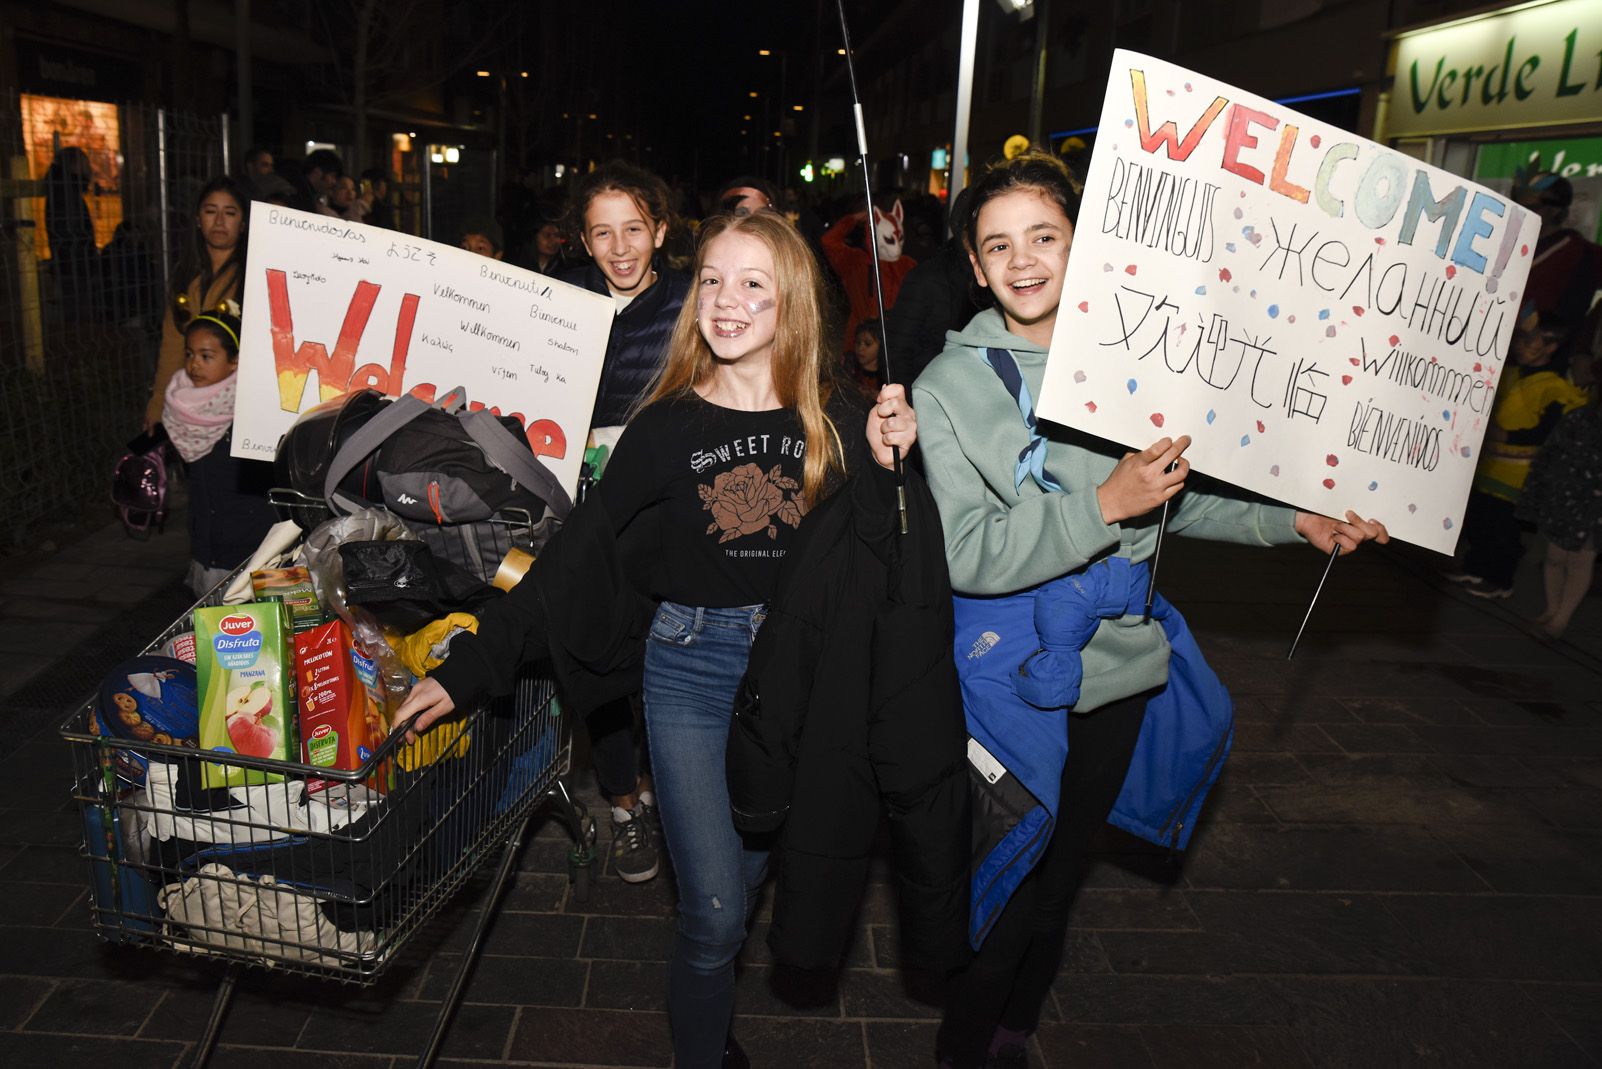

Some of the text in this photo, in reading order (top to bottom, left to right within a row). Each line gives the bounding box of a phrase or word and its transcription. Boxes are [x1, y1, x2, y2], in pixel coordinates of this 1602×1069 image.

[1410, 33, 1541, 114] Verde
[1129, 69, 1527, 293] WELCOME!
[1099, 285, 1330, 425] 欢迎光临
[690, 434, 805, 473] SWEET RO
[725, 549, 737, 558] THE
[740, 549, 770, 558] ORIGINAL
[222, 620, 252, 630] Juver
[217, 637, 260, 649] Disfruta
[240, 670, 266, 678] MANZANA
